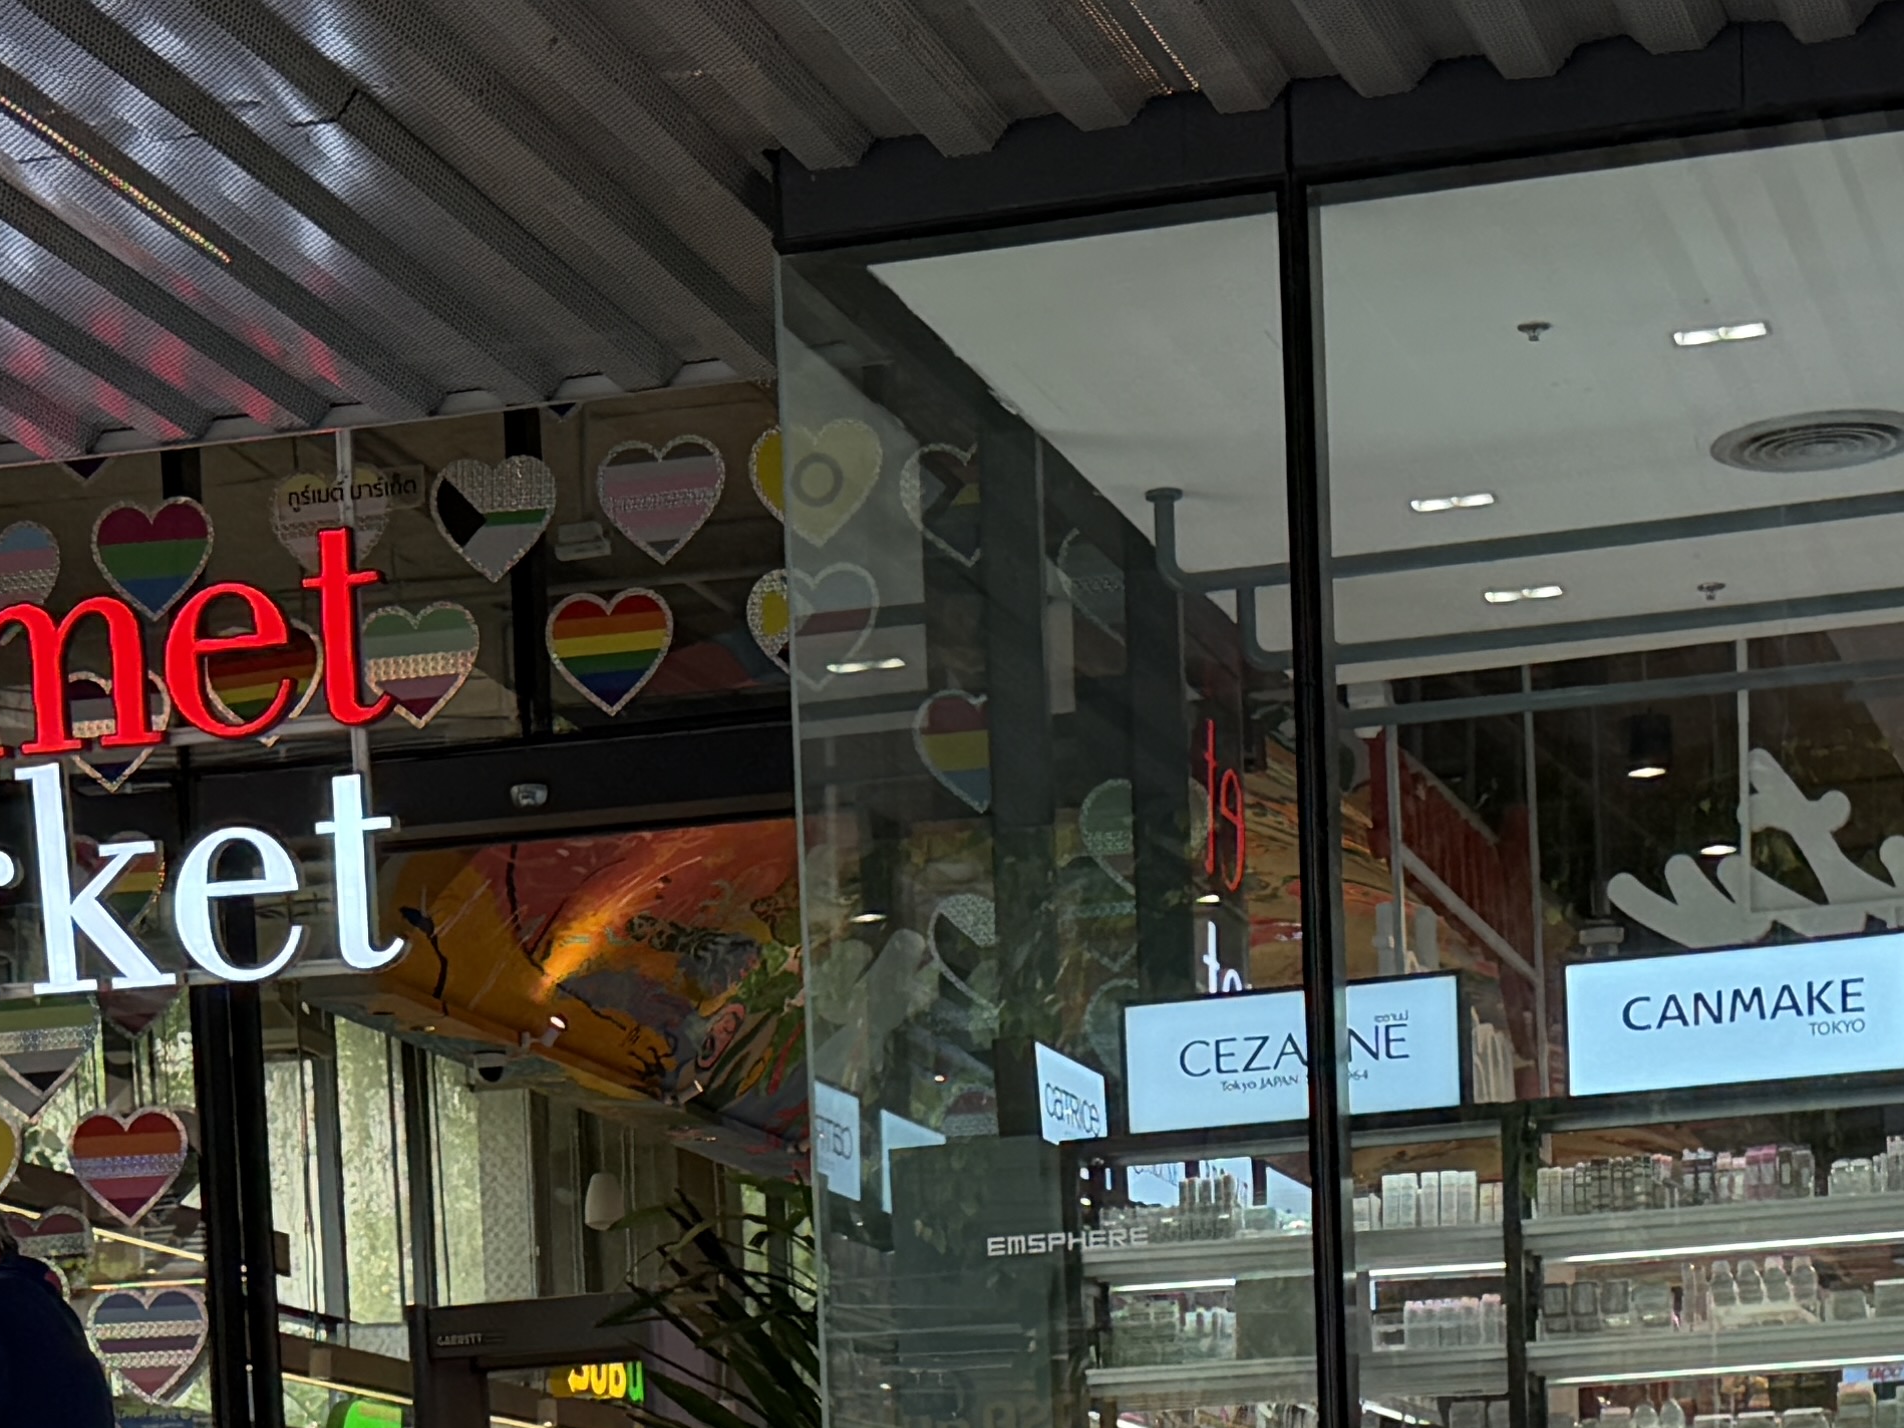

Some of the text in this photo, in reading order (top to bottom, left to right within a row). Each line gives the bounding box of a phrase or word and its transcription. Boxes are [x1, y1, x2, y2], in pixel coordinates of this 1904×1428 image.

[1621, 977, 1866, 1032] CANMAKE
[1808, 1018, 1866, 1037] TOKYO
[1178, 1022, 1411, 1078] CEZANE
[1258, 1073, 1300, 1091] JAPAN
[986, 1226, 1149, 1257] EMSPHERE
